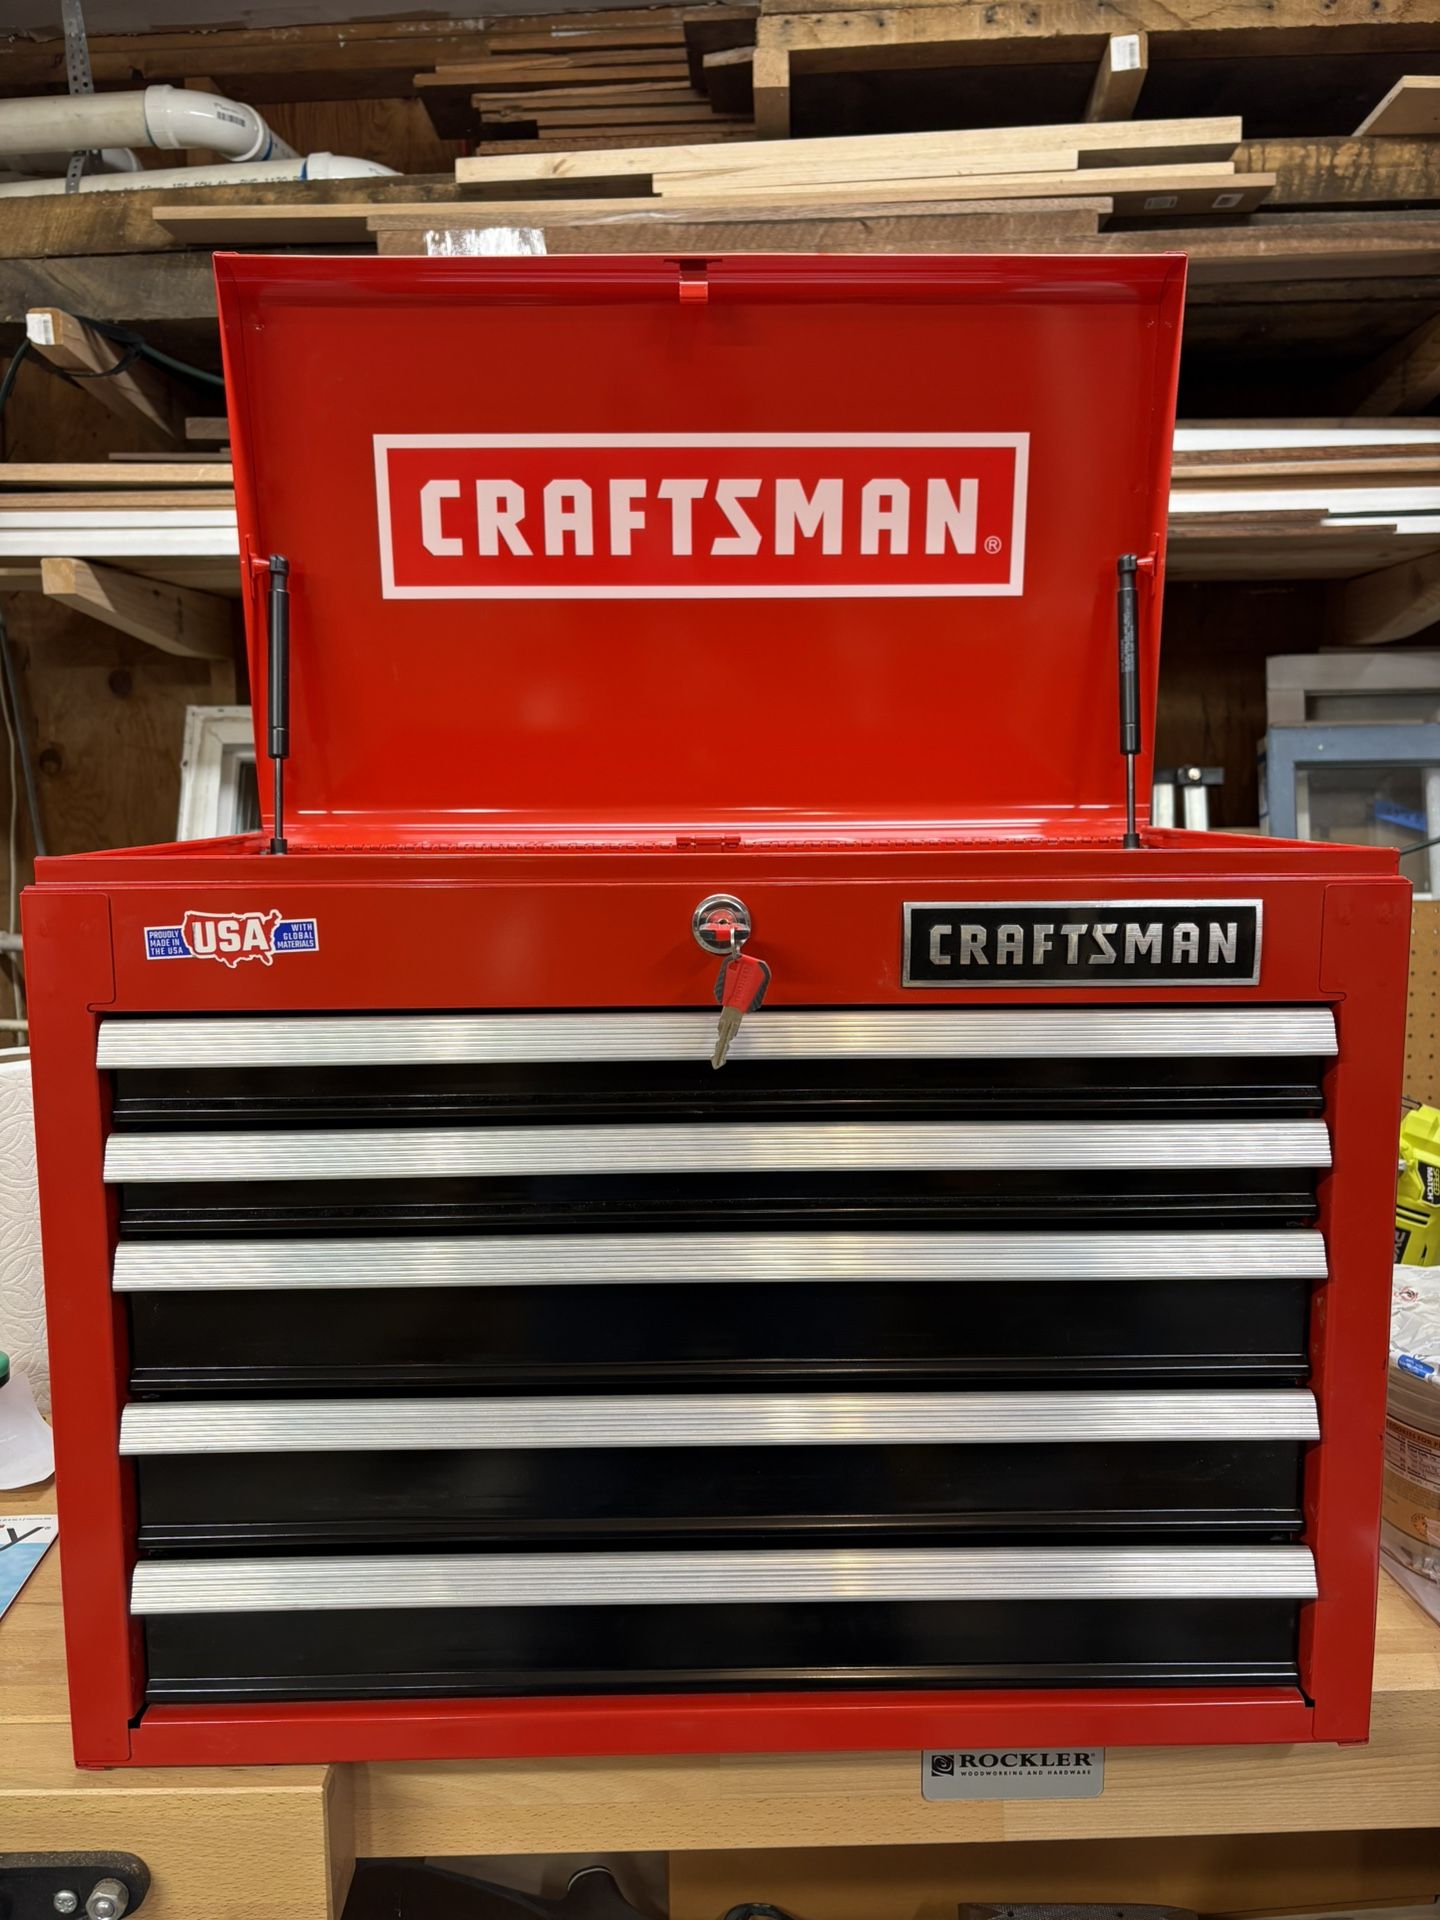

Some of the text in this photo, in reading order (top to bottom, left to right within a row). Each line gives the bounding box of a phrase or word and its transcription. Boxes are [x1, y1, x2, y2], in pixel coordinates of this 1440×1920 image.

[420, 478, 979, 556] CRAFTSMAN
[291, 923, 313, 932] WITH
[149, 930, 179, 939] PROUDLY
[192, 918, 269, 954] USA
[283, 932, 314, 940] GLOBAL
[150, 938, 180, 947] MADE IN
[277, 939, 314, 949] MATERIALS
[929, 922, 1238, 966] CRAFTSMAN
[151, 947, 184, 955] THE USA
[959, 1752, 1093, 1768] ROCKLER
